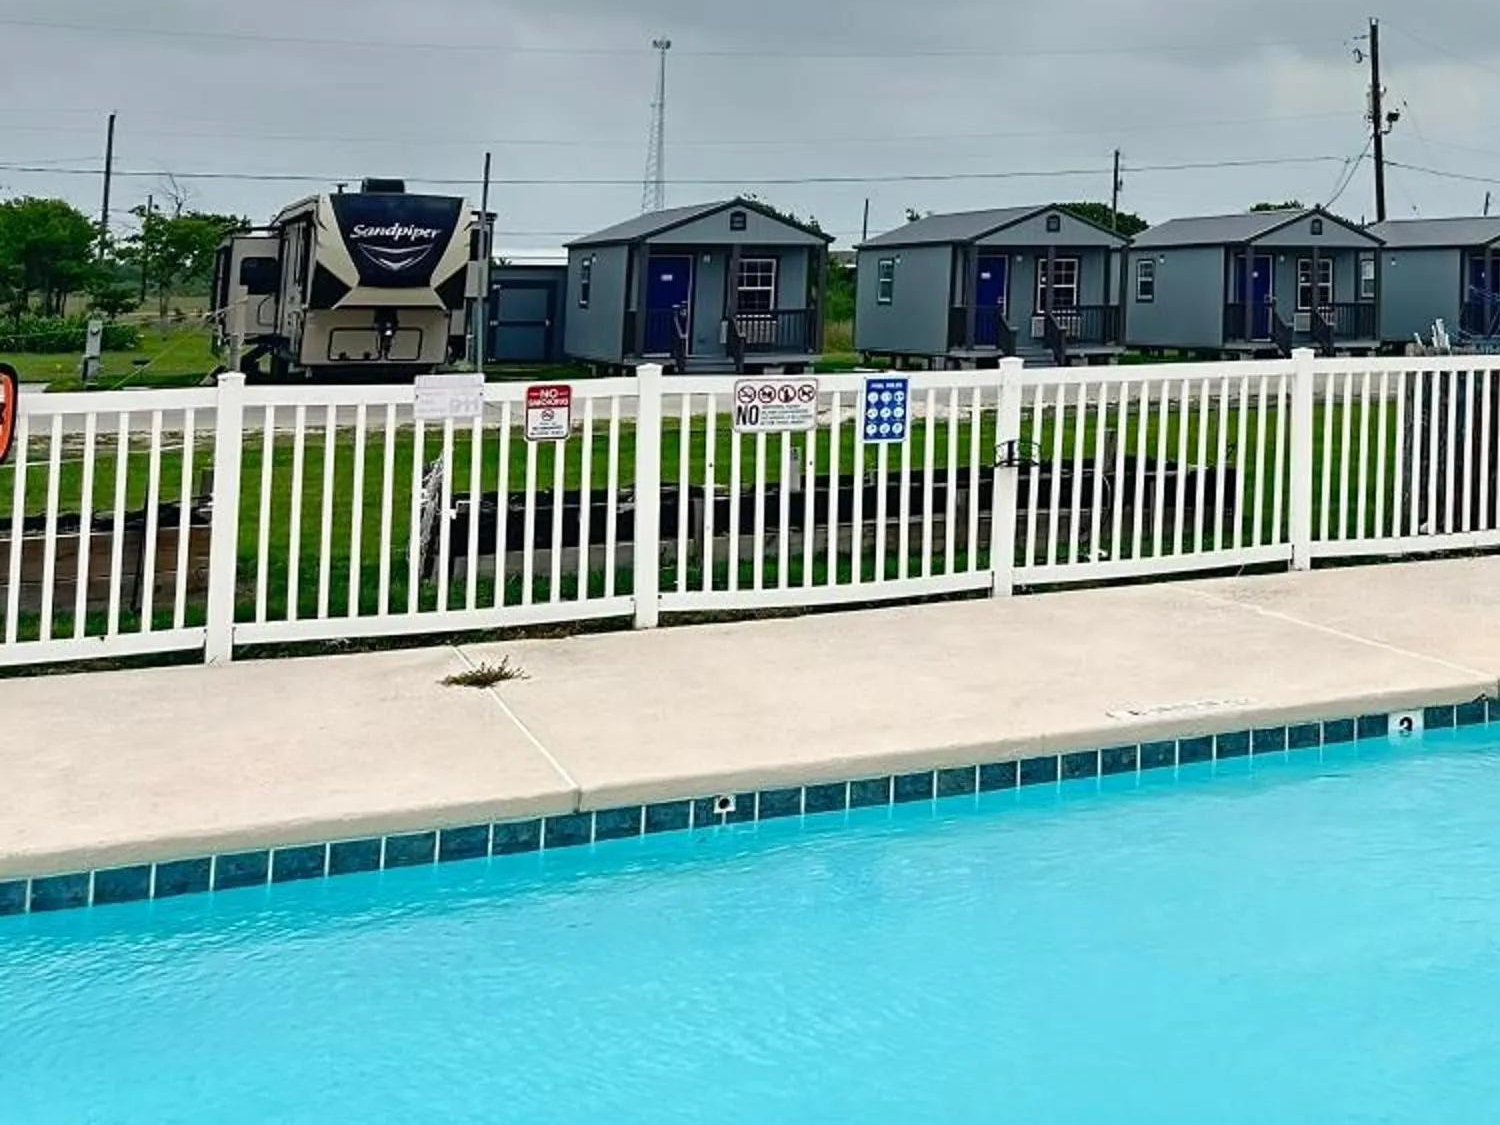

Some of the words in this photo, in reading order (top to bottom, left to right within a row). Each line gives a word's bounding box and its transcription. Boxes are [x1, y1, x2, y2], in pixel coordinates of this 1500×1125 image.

[350, 223, 441, 241] Sandpiper
[540, 388, 559, 398] NO
[736, 405, 759, 425] NO
